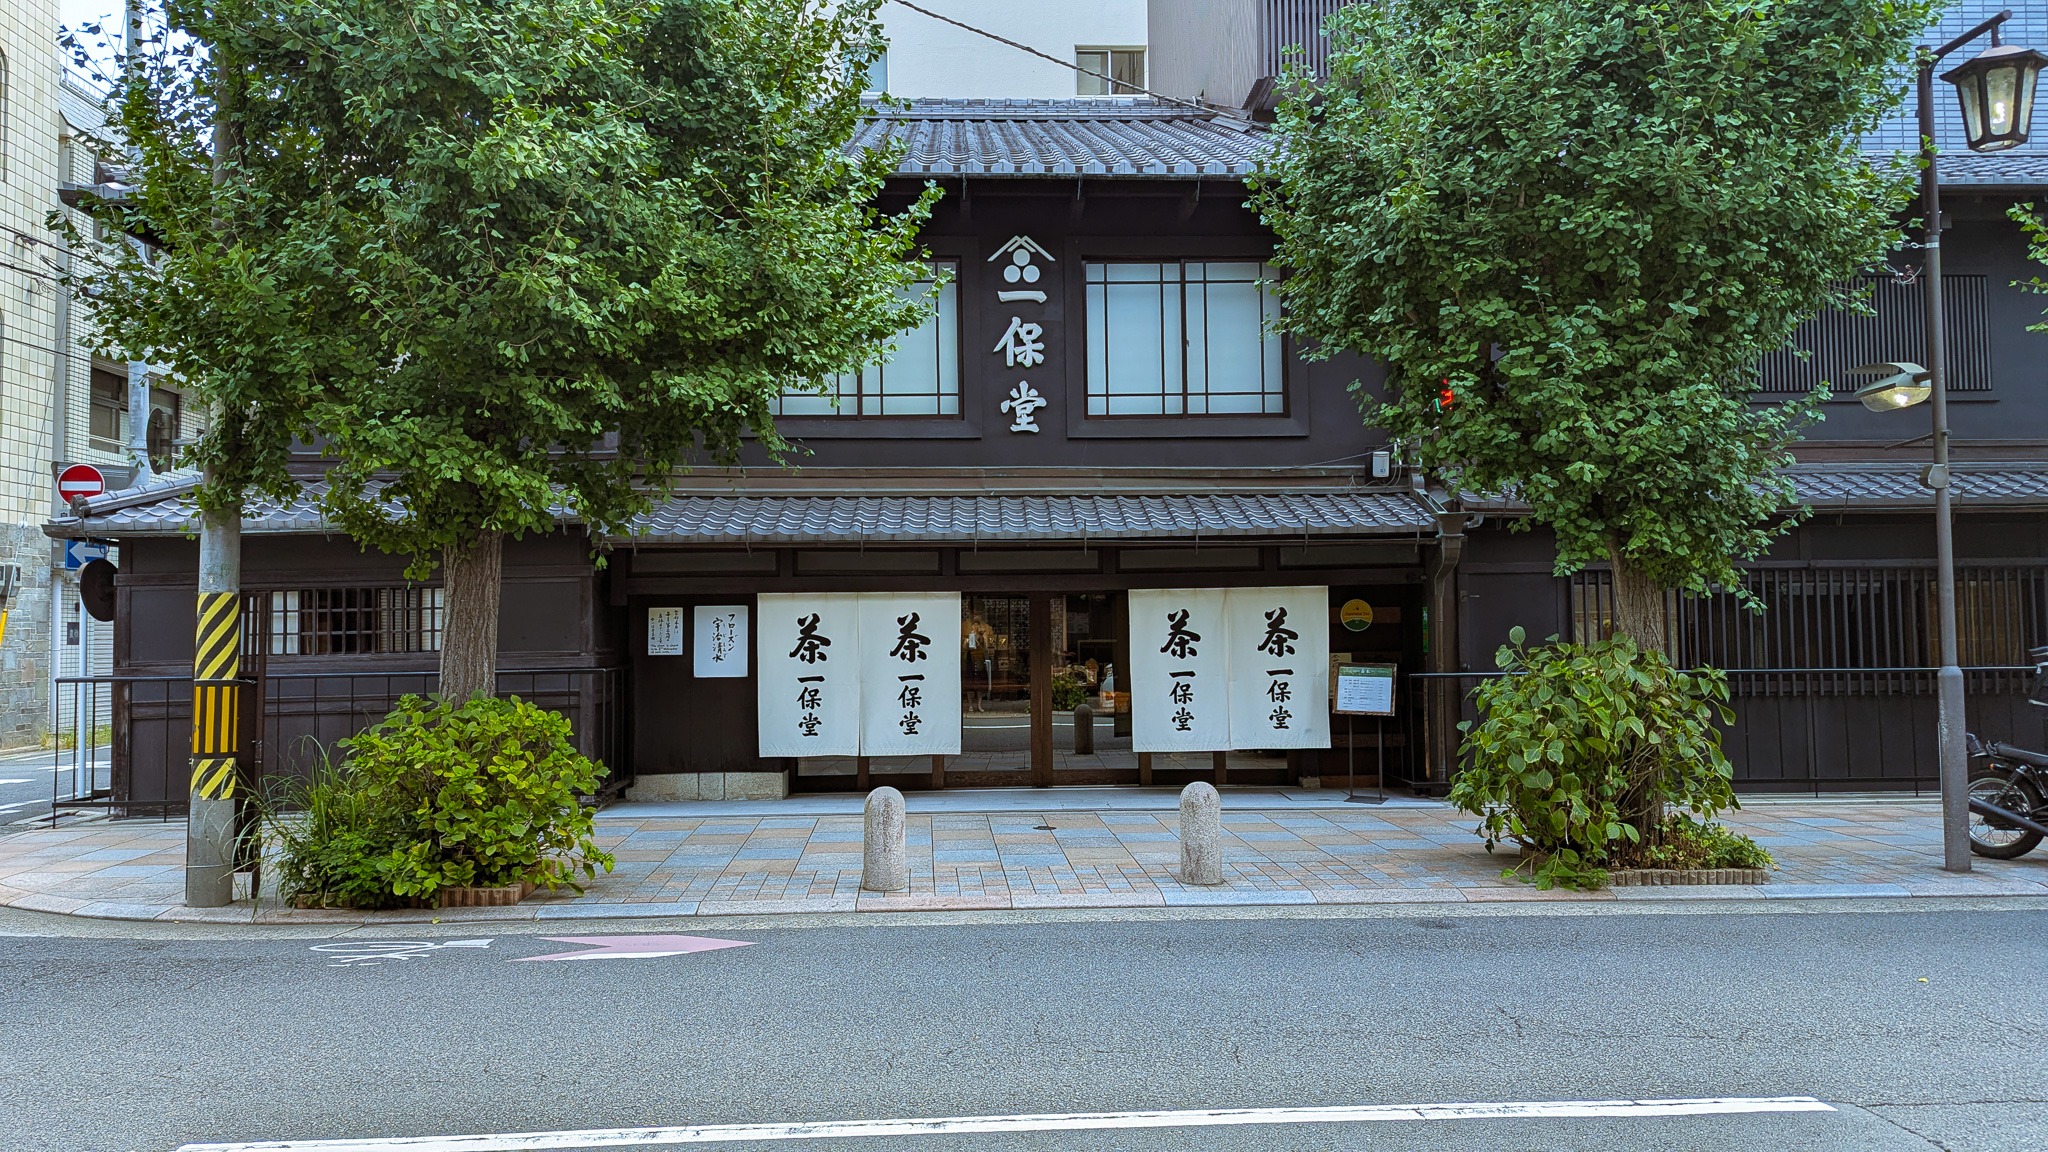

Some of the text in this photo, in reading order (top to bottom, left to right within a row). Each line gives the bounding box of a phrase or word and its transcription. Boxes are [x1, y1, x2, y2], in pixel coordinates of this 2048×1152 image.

[993, 290, 1047, 433] 一保堂
[712, 617, 724, 663] 宇治清水
[727, 614, 738, 652] フローズン
[788, 612, 832, 737] 茶 一保堂
[889, 611, 932, 736] 茶 一保堂
[1159, 608, 1202, 732] 茶 一保堂
[1257, 606, 1299, 730] 茶 一保堂
